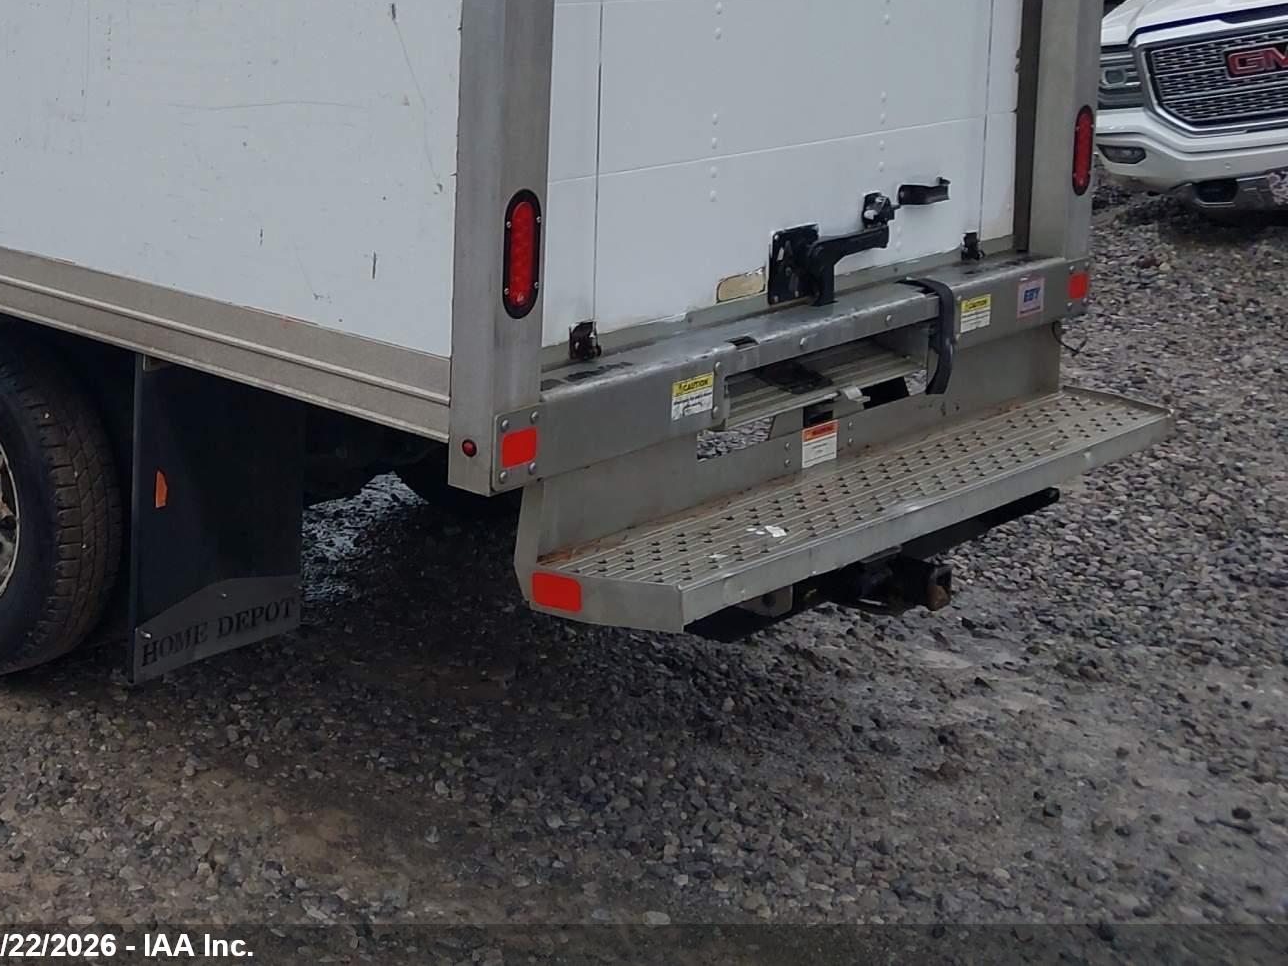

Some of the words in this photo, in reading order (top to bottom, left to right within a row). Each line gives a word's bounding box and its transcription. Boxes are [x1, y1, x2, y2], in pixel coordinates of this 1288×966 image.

[683, 378, 709, 392] CAUTION
[141, 621, 209, 666] HOME
[216, 597, 296, 639] DEPOT
